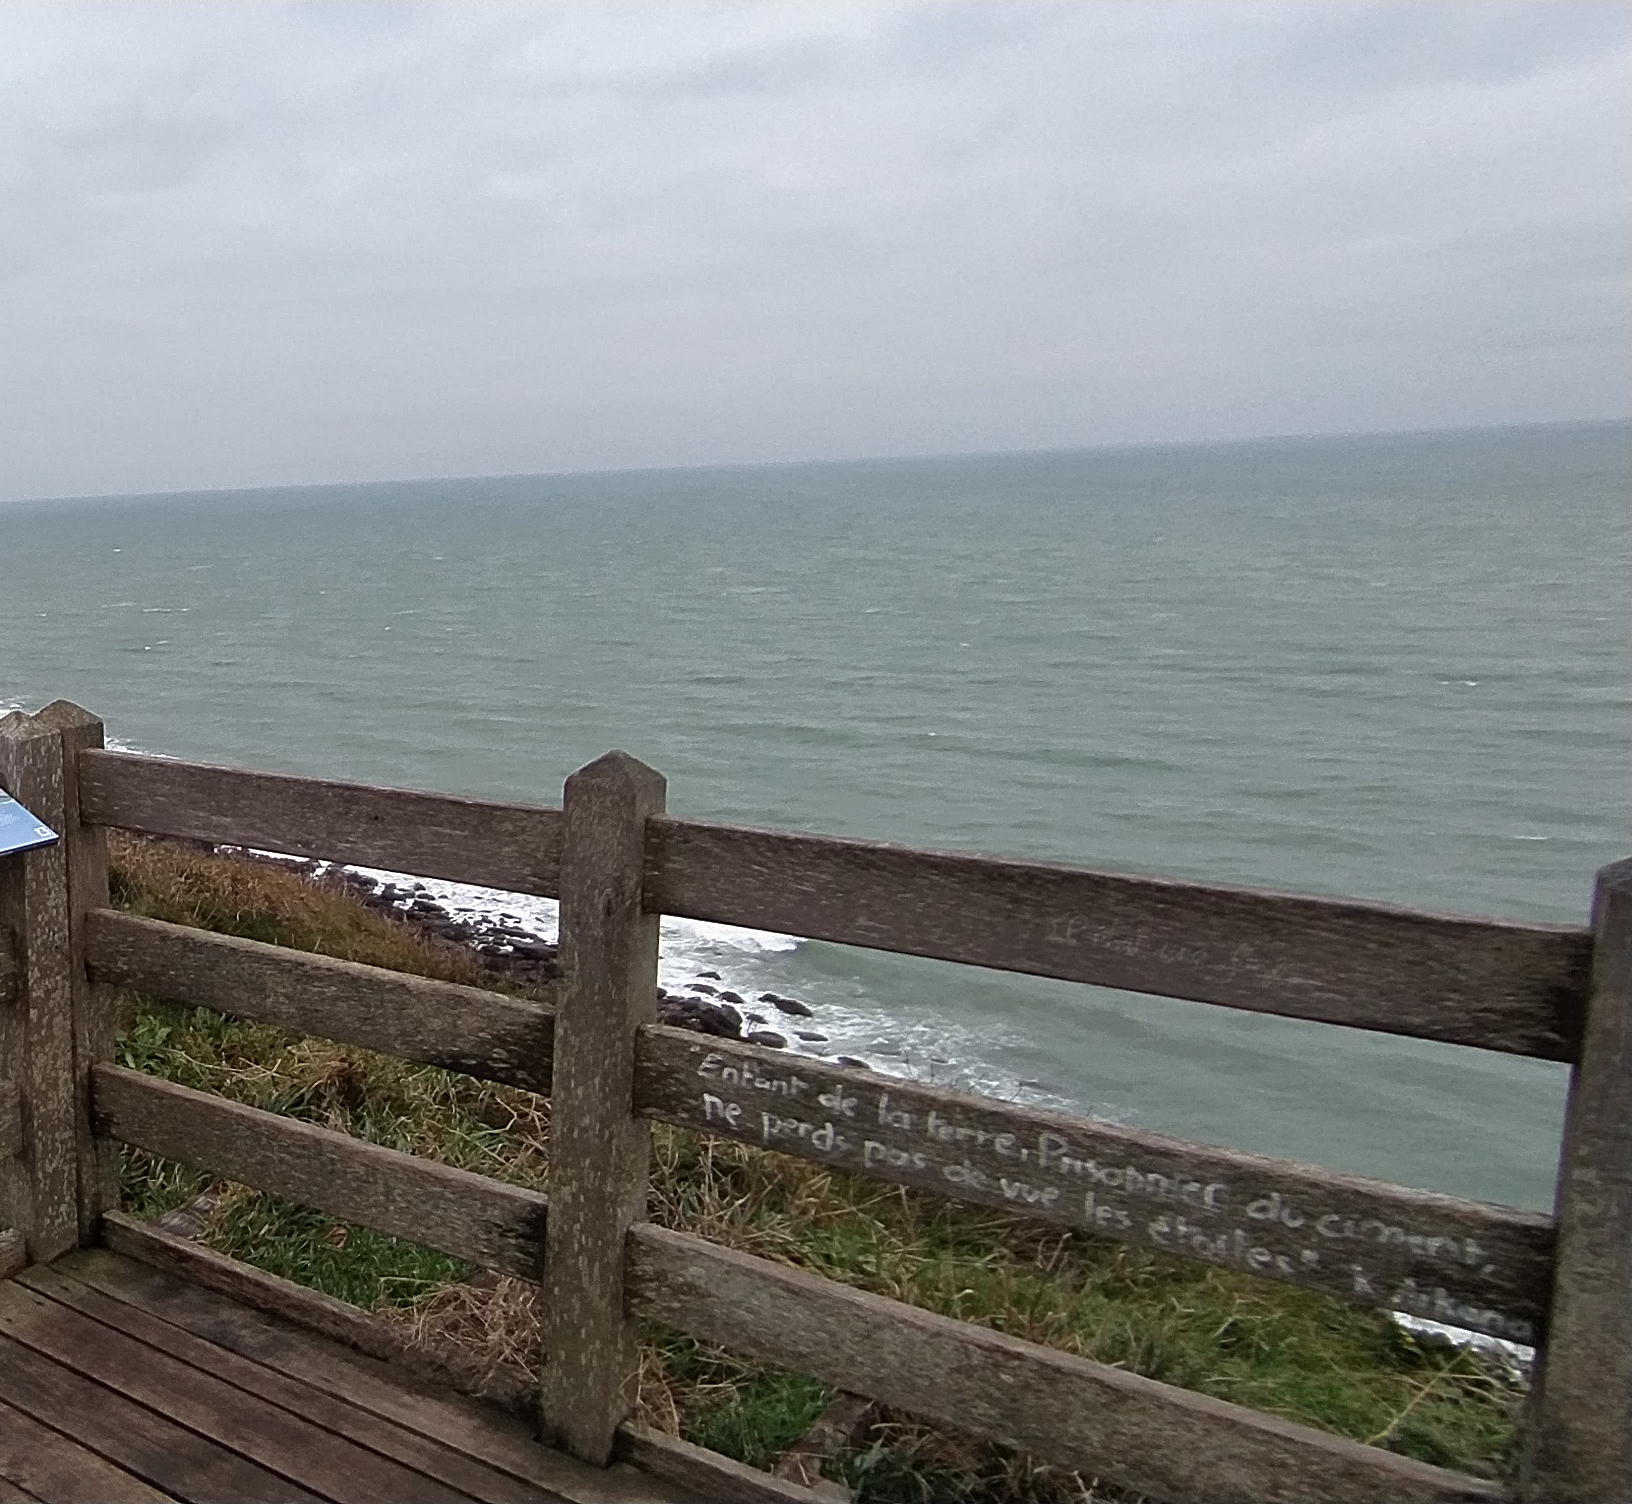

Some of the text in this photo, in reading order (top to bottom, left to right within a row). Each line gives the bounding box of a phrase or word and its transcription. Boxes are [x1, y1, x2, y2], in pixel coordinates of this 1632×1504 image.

[818, 1084, 858, 1117] de
[878, 1093, 917, 1130] la
[1246, 1192, 1305, 1228] du
[864, 1140, 926, 1169] pas
[999, 1177, 1061, 1208] vue
[1084, 1191, 1133, 1231] les
